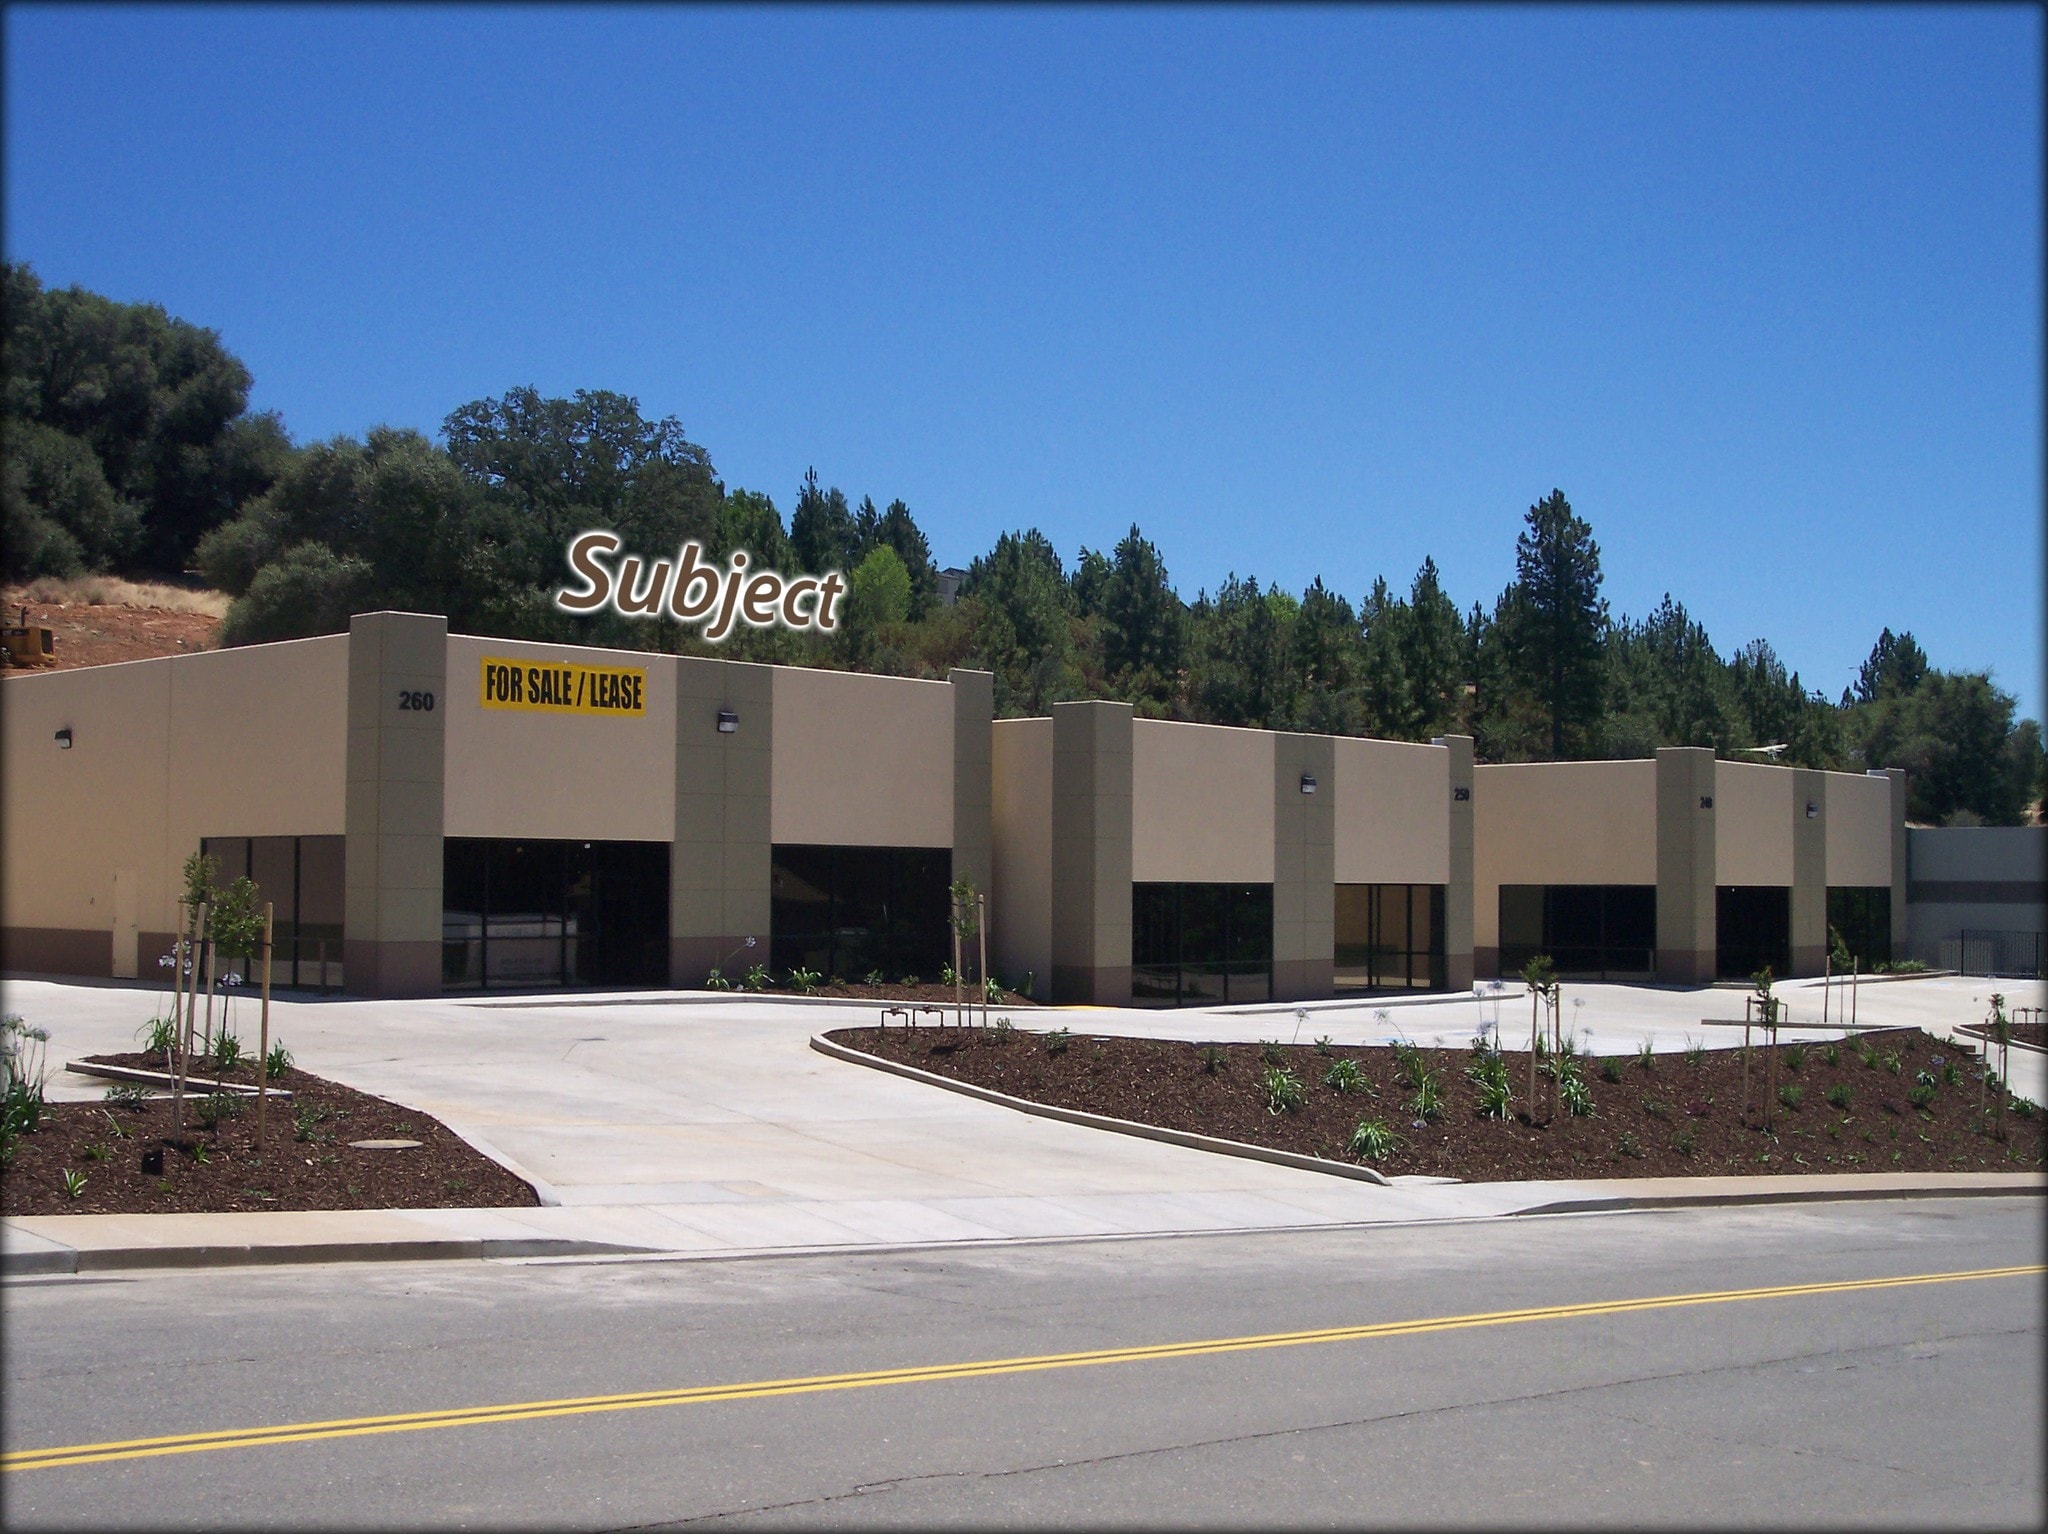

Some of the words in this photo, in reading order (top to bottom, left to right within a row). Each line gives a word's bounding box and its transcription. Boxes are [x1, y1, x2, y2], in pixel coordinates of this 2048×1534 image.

[486, 664, 523, 703] FOR
[527, 667, 573, 706] SALE
[576, 671, 586, 707] /
[590, 672, 642, 710] LEASE
[398, 690, 435, 712] 260
[1453, 787, 1470, 802] 250
